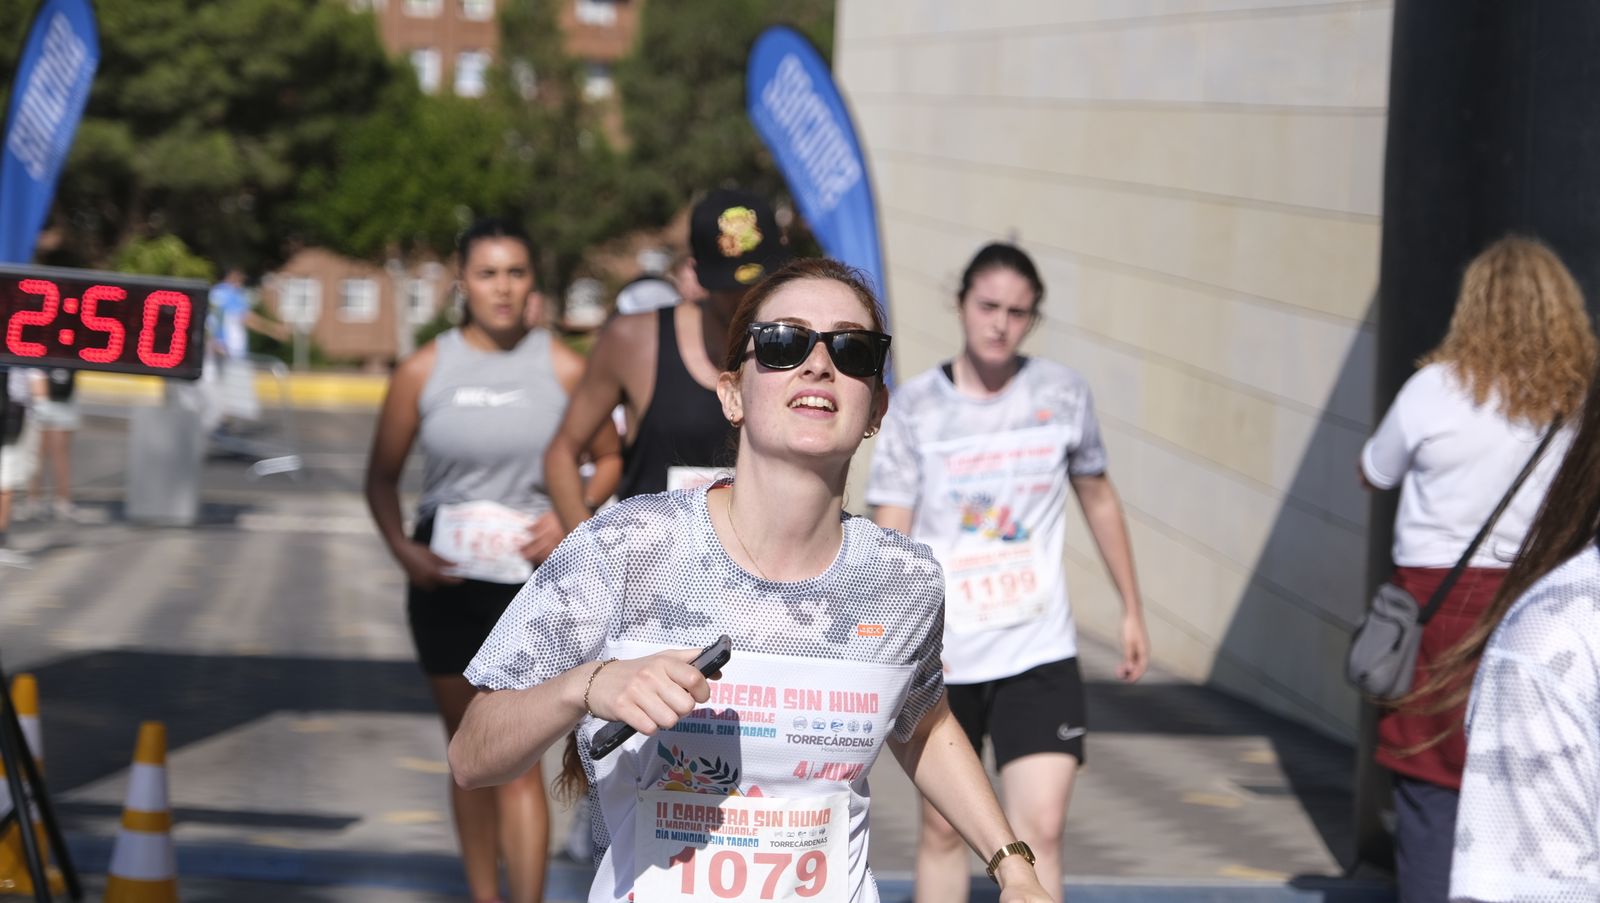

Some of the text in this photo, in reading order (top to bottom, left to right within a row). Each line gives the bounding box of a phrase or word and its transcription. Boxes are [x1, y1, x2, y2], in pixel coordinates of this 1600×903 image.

[6, 278, 192, 368] 2:50
[959, 569, 1036, 603] 1199
[709, 682, 879, 714] RRERA SIN HUMO
[710, 708, 776, 724] SALUDABLE
[716, 724, 735, 736] SIN
[739, 726, 776, 738] TABACO
[786, 733, 874, 747] TORRECÁRDENAS
[656, 802, 832, 827] II CARRERA SIN HUMO
[655, 828, 760, 848] DÍA MUNDIAL SIN TABACO
[665, 821, 702, 834] MARCHA
[704, 824, 758, 837] SALUDABLE
[770, 836, 828, 848] TORRECÁRDENAS
[669, 848, 828, 900] 1079
